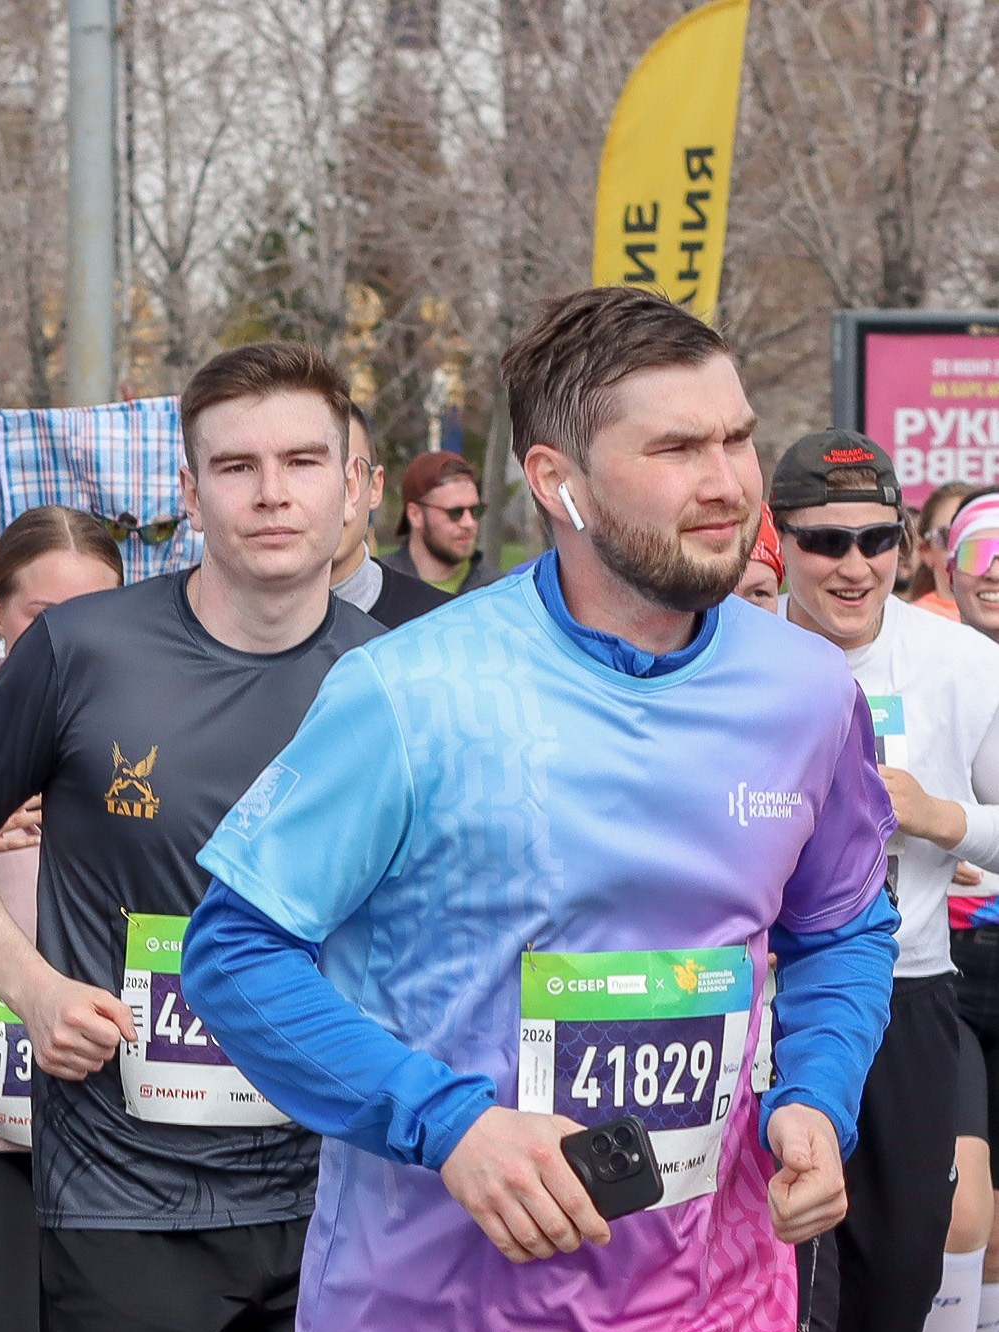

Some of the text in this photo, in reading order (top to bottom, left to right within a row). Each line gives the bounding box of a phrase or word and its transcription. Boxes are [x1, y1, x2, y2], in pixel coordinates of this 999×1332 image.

[624, 202, 659, 283] ИЕ
[748, 791, 803, 805] КОМАНДА
[748, 804, 793, 818] КАЗАНИ
[126, 976, 149, 989] 2026
[567, 978, 605, 992] СБЕР
[155, 992, 220, 1047] 42
[522, 1028, 552, 1042] 2026
[571, 1040, 713, 1109] 41829
[155, 1087, 207, 1101] МАГНИТ
[716, 1094, 730, 1121] D
